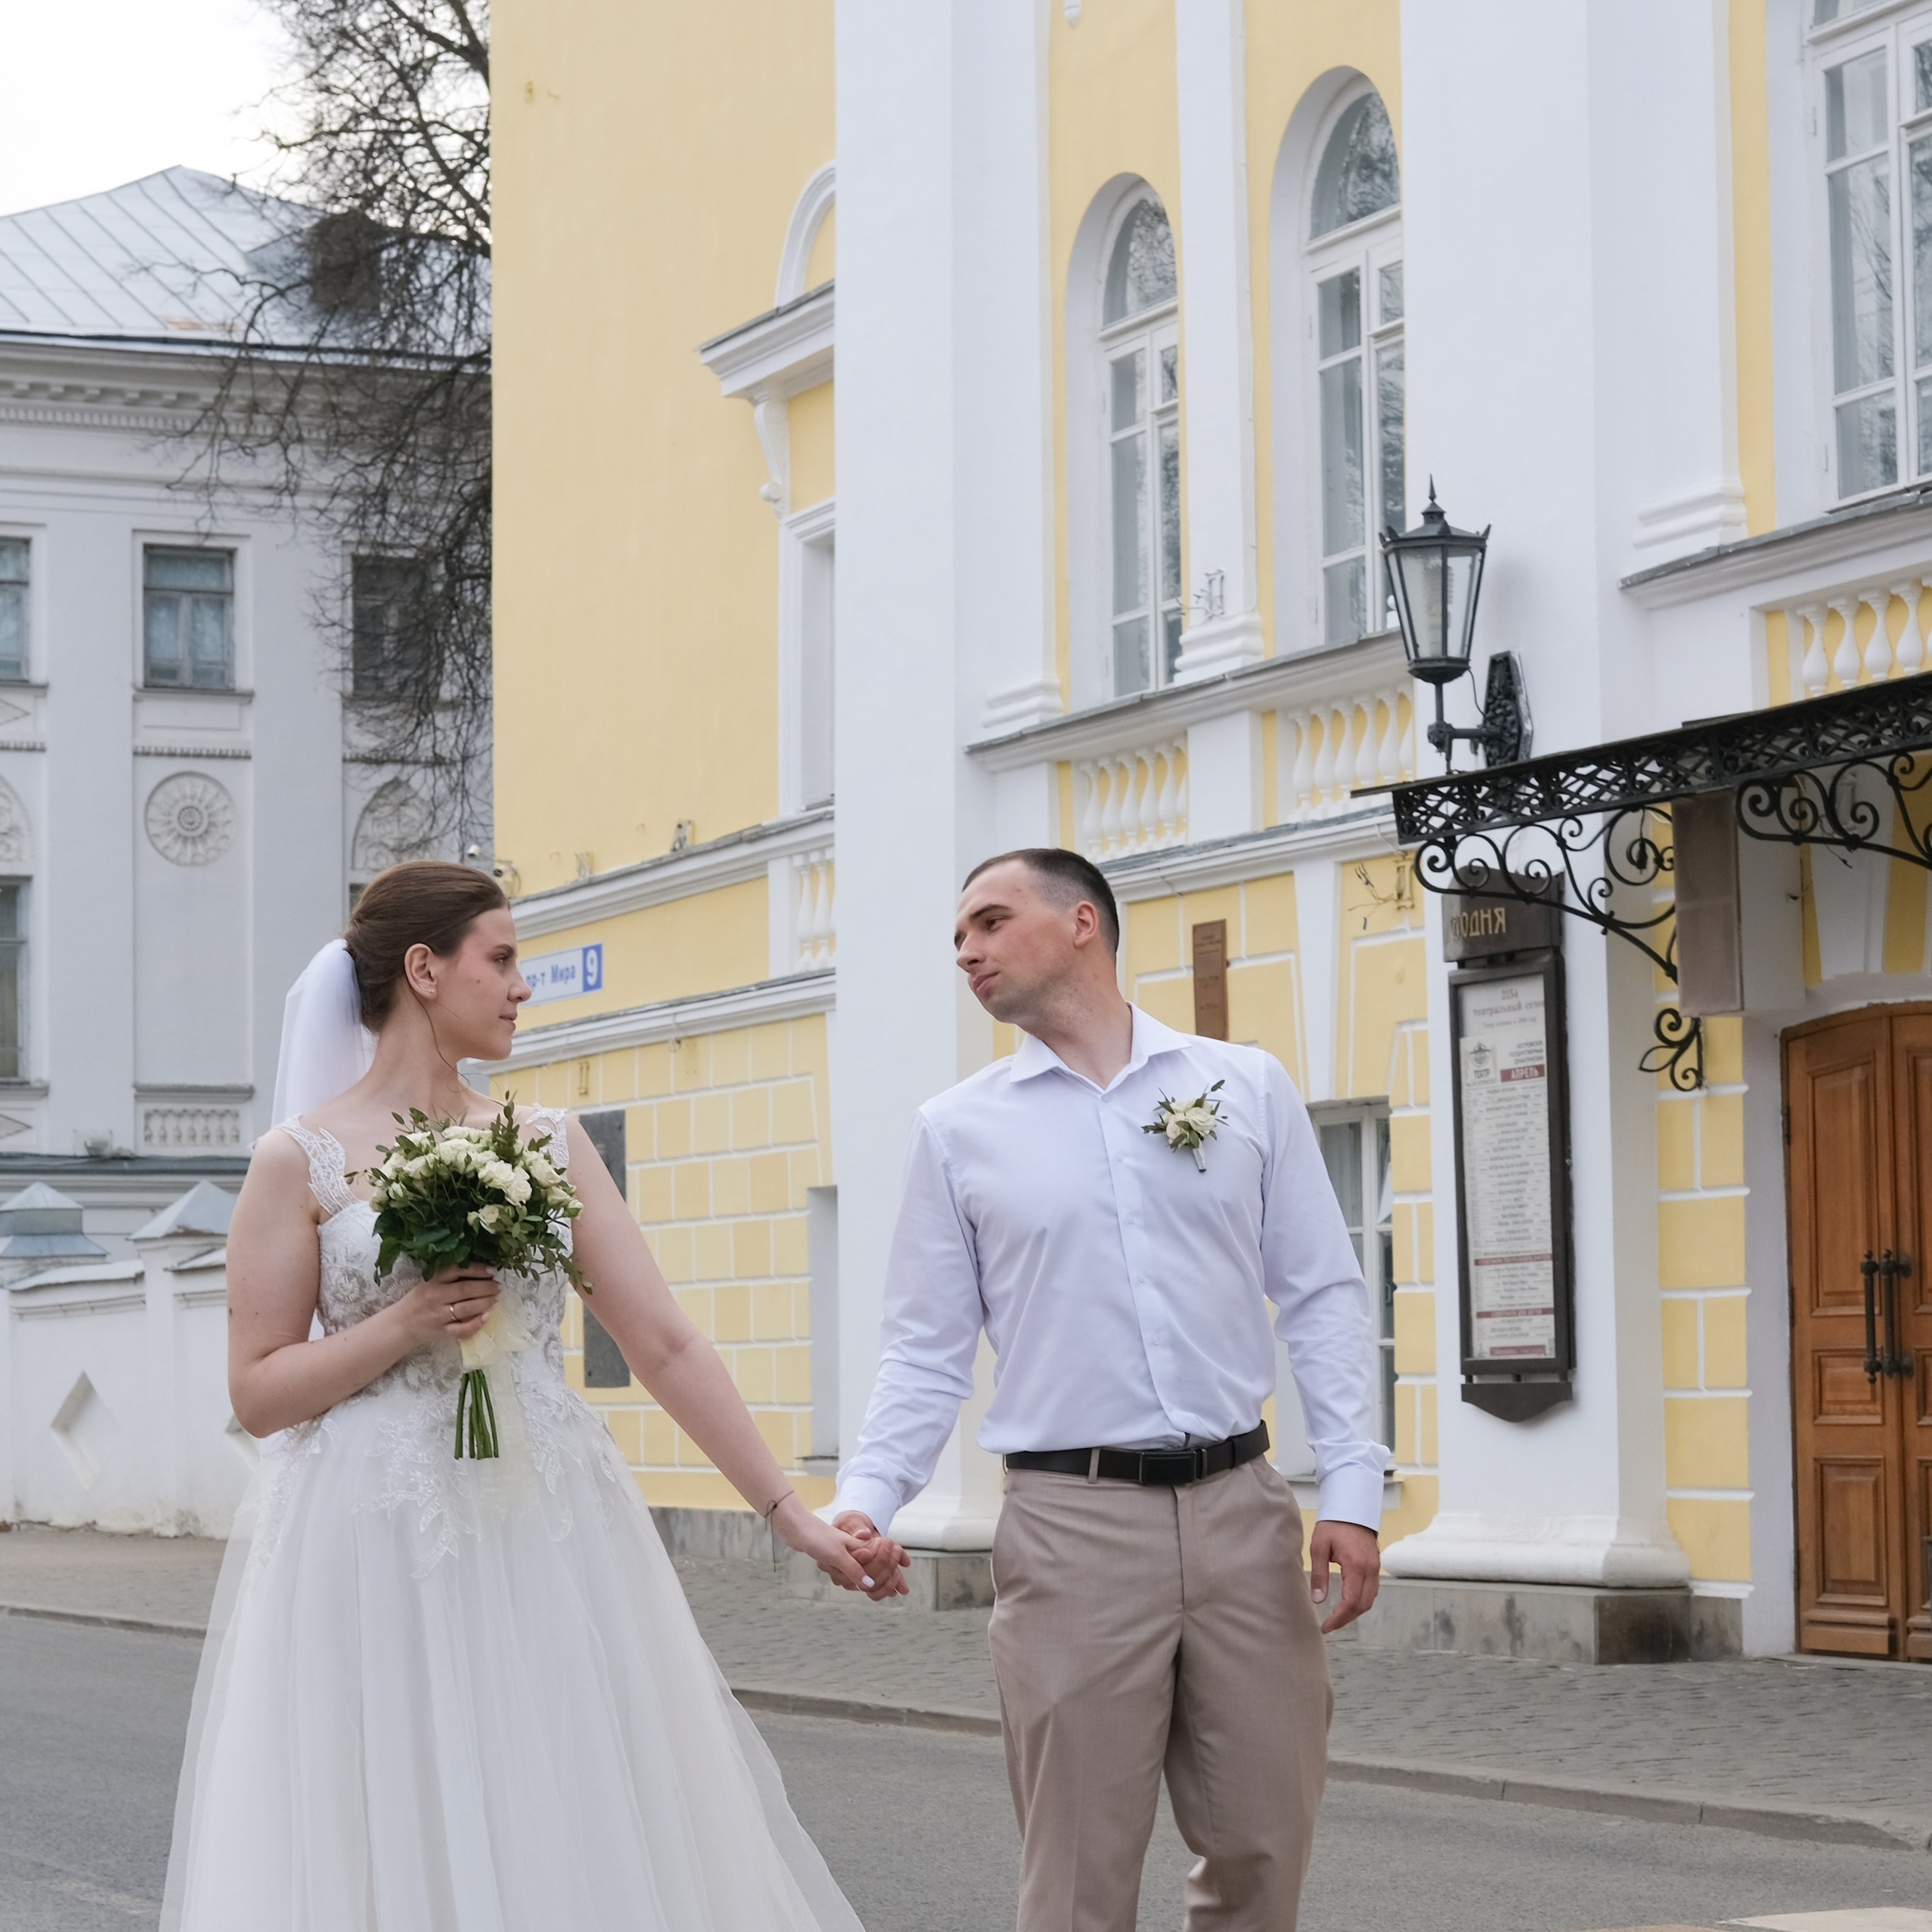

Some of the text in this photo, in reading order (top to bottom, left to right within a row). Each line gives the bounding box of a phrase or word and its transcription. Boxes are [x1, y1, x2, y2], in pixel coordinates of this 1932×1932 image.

[526, 949, 598, 992] пр-т Мира 9
[1511, 1066, 1540, 1079] АПРЕЛЬ
